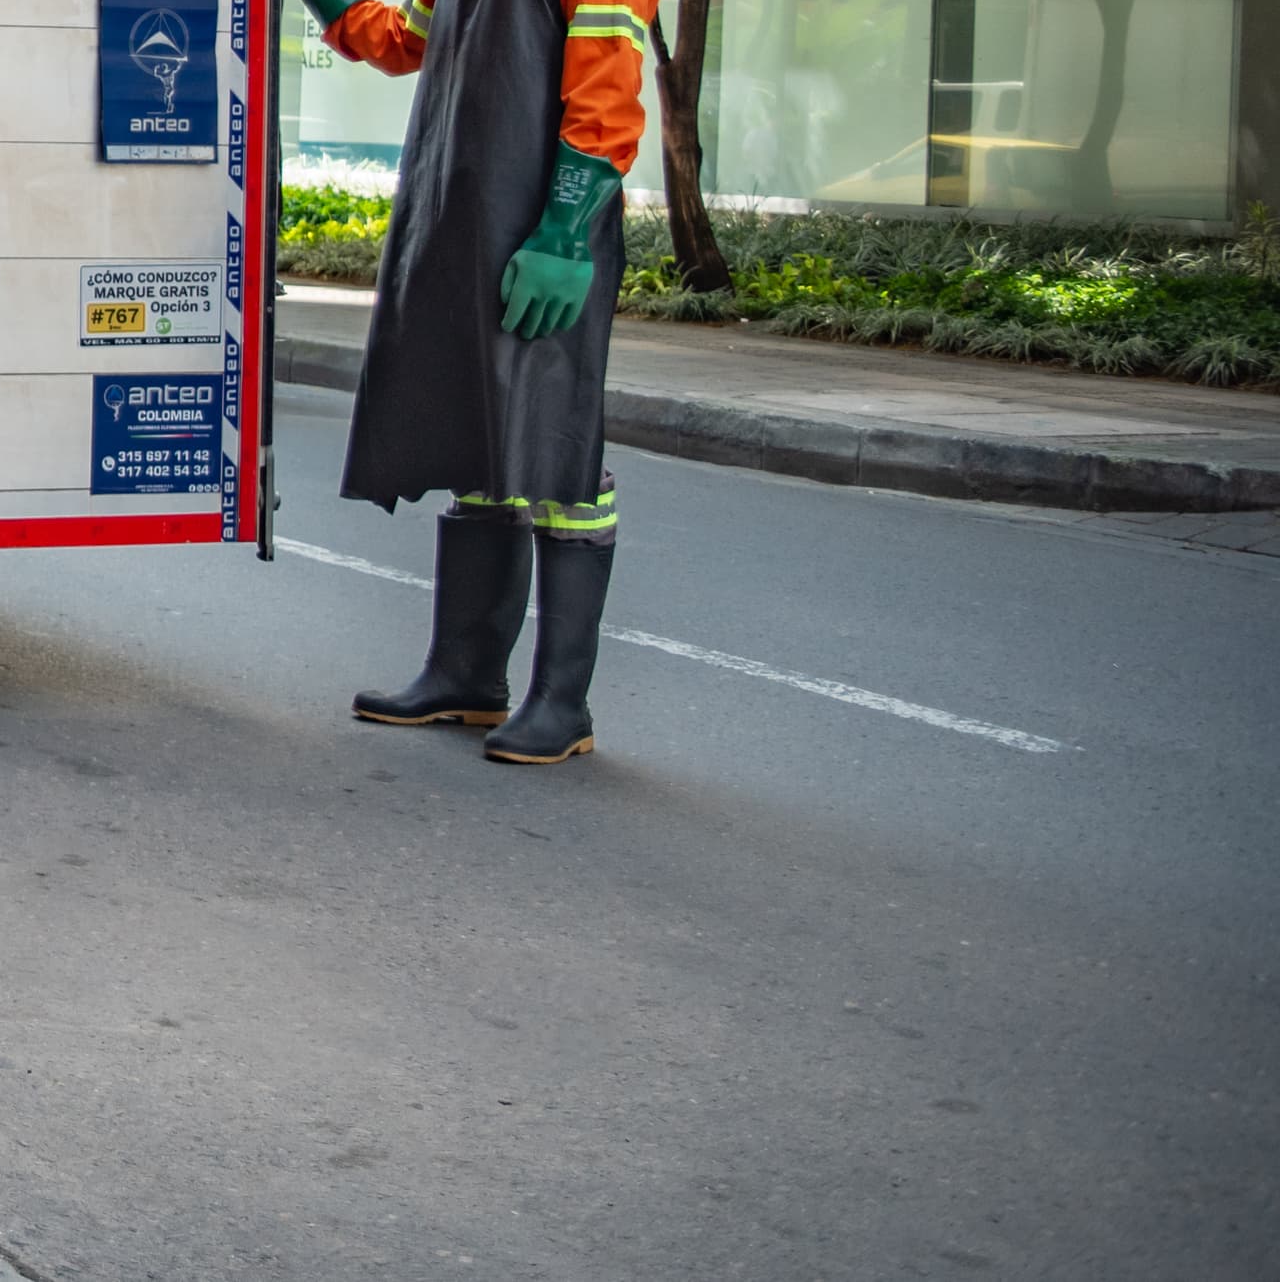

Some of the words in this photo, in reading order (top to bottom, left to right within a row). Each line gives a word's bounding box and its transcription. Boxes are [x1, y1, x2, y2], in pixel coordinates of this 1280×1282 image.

[130, 118, 190, 132] anteo
[230, 104, 243, 176] anteo
[228, 226, 240, 299] anteo
[87, 270, 133, 286] ¿CÓMO
[137, 271, 217, 284] CONDUZCO?
[94, 286, 155, 300] MARQUE
[159, 285, 209, 298] GRATIS
[151, 300, 198, 315] Opción
[203, 301, 211, 312] 3
[91, 308, 139, 324] #767
[114, 337, 143, 345] MAX
[225, 344, 238, 417] anteo
[128, 384, 213, 405] anteo
[137, 409, 204, 422] COLOMBIA
[117, 451, 142, 462] 315
[145, 450, 170, 462] 697
[174, 450, 190, 461] 11
[193, 450, 209, 461] 42
[117, 466, 142, 477] 317
[145, 465, 170, 477] 402
[174, 465, 189, 476] 54
[193, 465, 209, 476] 34
[223, 466, 235, 538] anteo
